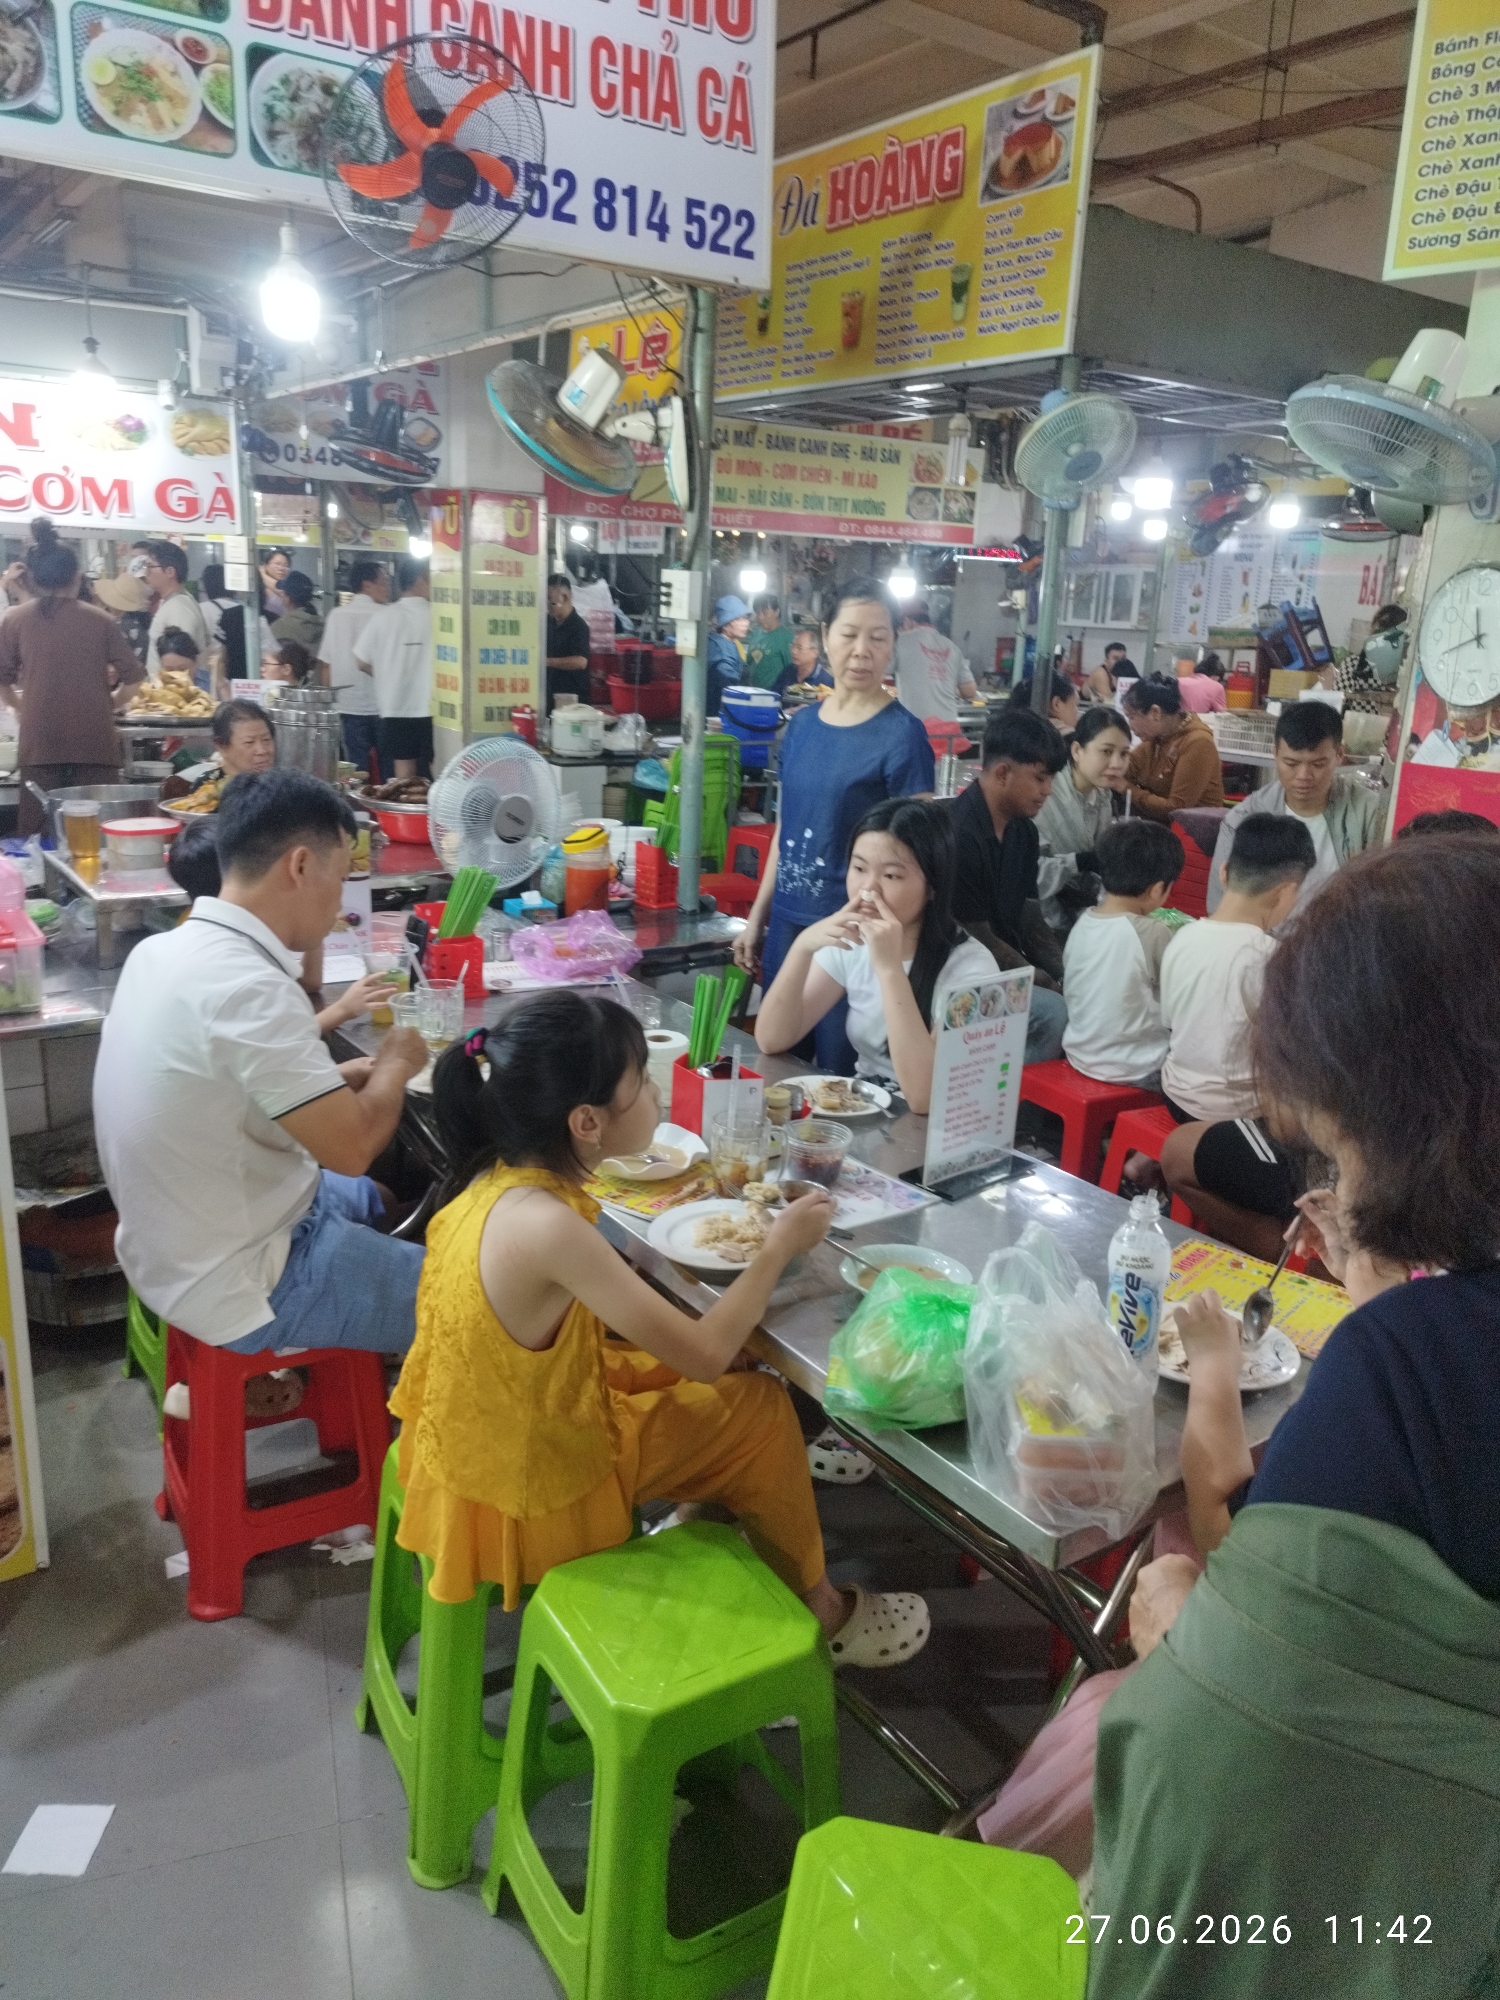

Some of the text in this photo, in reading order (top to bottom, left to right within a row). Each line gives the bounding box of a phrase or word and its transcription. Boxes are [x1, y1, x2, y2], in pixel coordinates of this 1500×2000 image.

[1434, 36, 1478, 55] Bánh
[1431, 63, 1475, 80] Bông
[589, 30, 683, 131] CHẢ
[697, 61, 756, 150] CÁ
[1428, 86, 1463, 104] Chè
[1469, 83, 1479, 97] 3
[1424, 110, 1459, 129] Chè
[1421, 136, 1456, 153] Chè
[826, 126, 965, 232] HOÀNG
[1418, 160, 1453, 177] Chè
[1414, 184, 1449, 202] Chè
[1455, 179, 1491, 197] Đậu
[593, 177, 670, 243] 814
[684, 196, 756, 260] 522
[1411, 208, 1446, 225] Chè
[1452, 204, 1487, 222] Đậu
[1408, 233, 1461, 250] Sương
[765, 431, 796, 452] BÁNH
[799, 437, 828, 456] CANH
[880, 443, 901, 465] SẢN
[0, 465, 237, 522] CƠM GÀ
[769, 486, 793, 508] SẢN
[1358, 553, 1384, 606] BÁ
